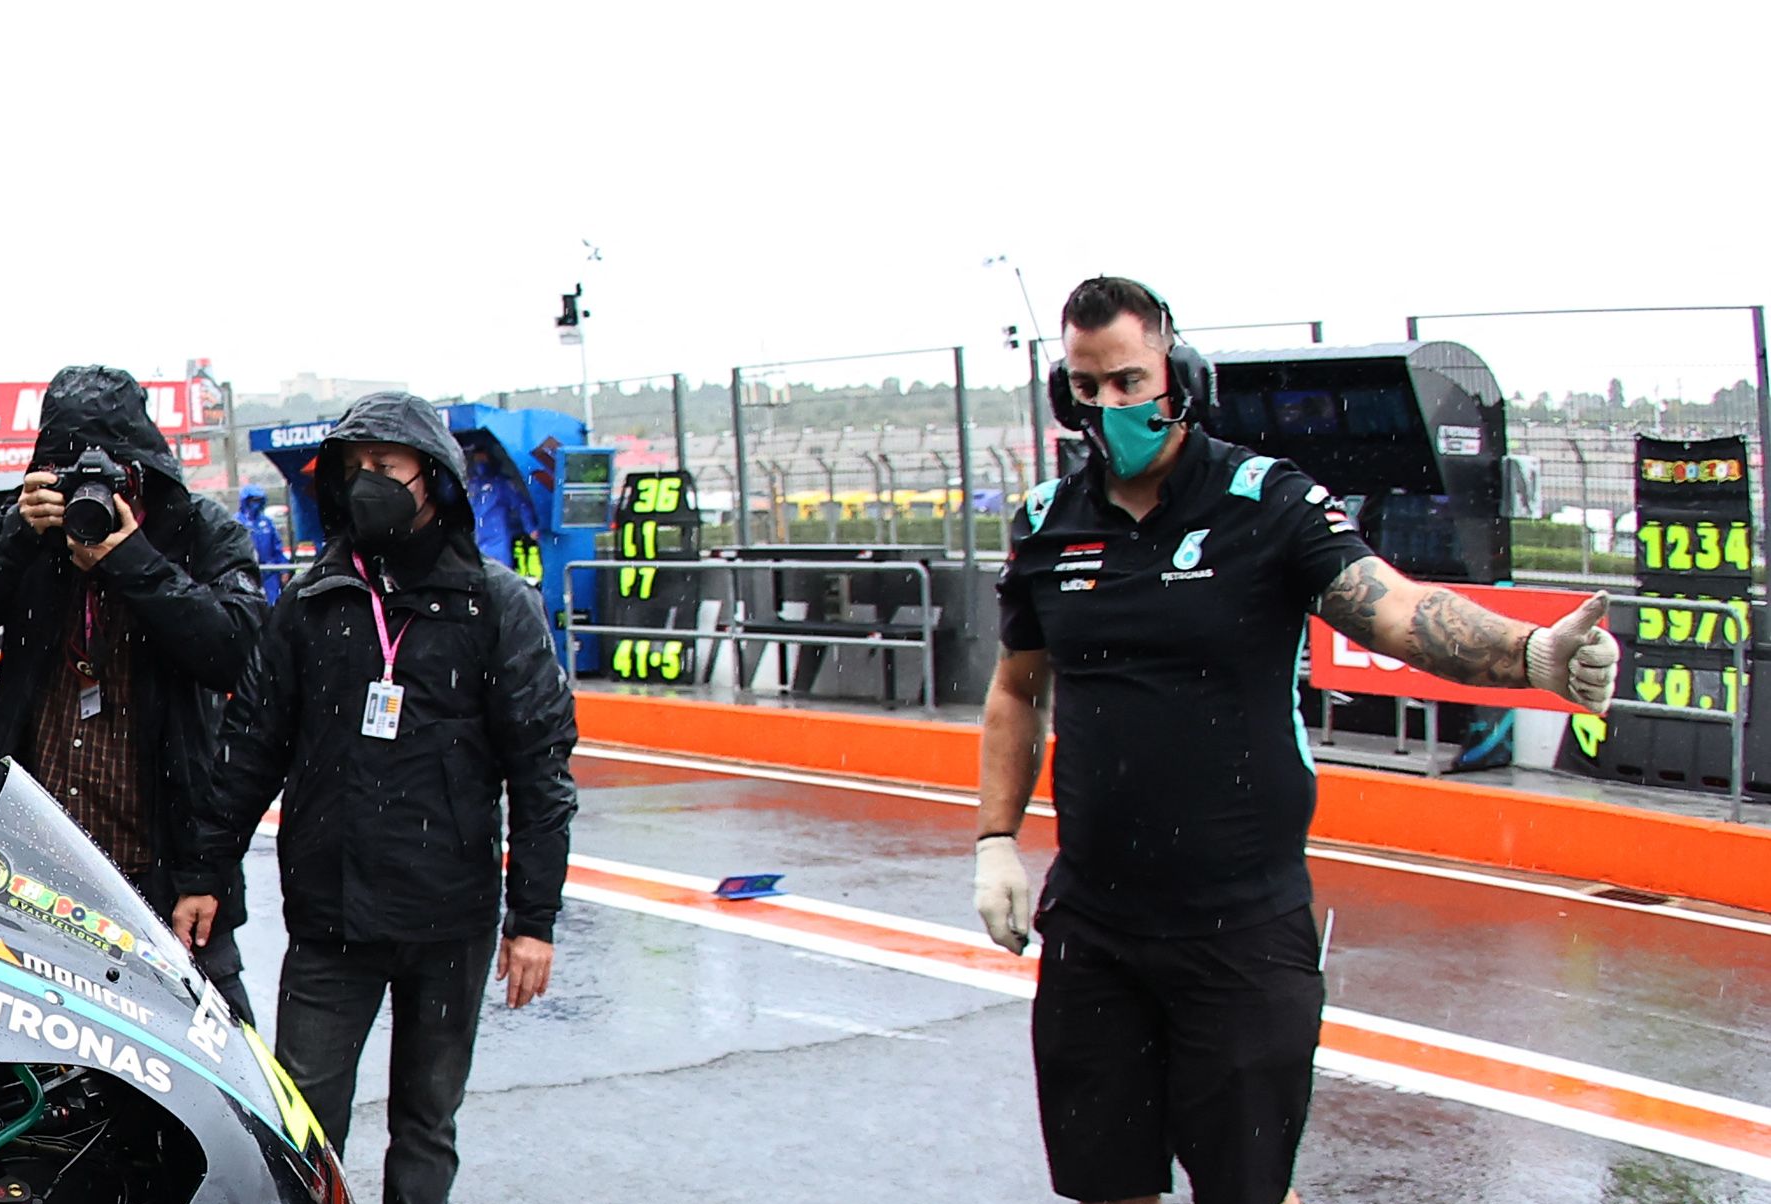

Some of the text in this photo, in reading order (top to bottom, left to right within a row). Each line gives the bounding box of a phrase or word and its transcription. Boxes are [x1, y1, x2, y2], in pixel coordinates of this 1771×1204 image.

[633, 477, 681, 513] 36
[1637, 521, 1749, 571] 1234
[54, 897, 134, 951] DOCTOR
